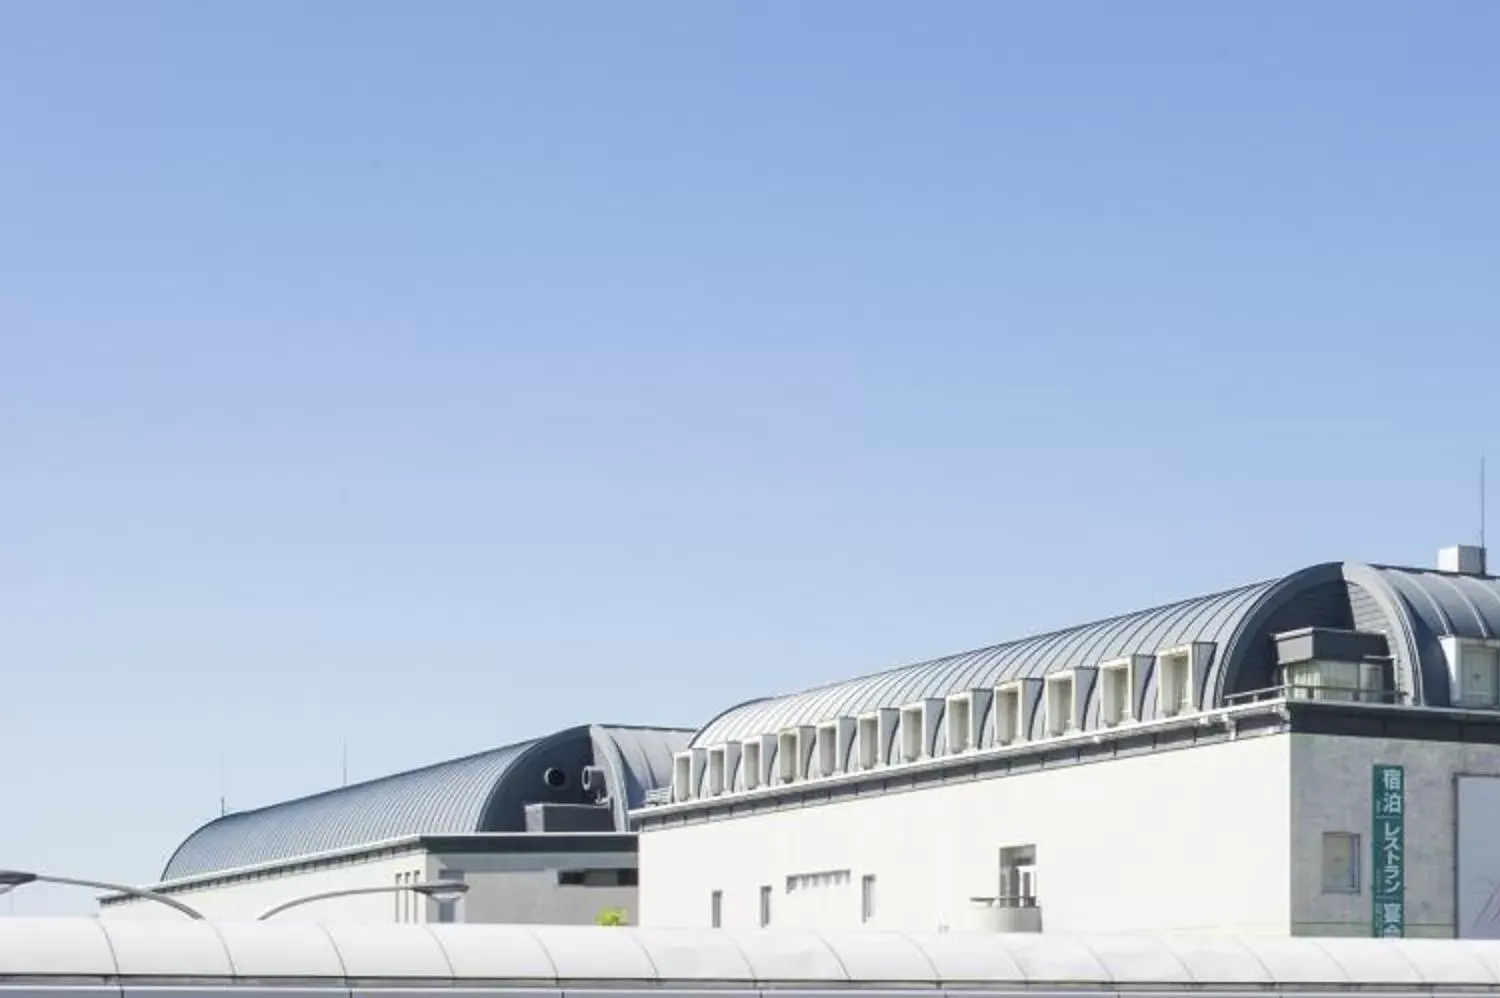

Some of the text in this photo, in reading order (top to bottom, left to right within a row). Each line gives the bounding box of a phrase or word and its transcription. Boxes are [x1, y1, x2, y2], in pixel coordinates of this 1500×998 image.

[1384, 769, 1402, 813] 宿泊
[1384, 821, 1401, 894] レストラン
